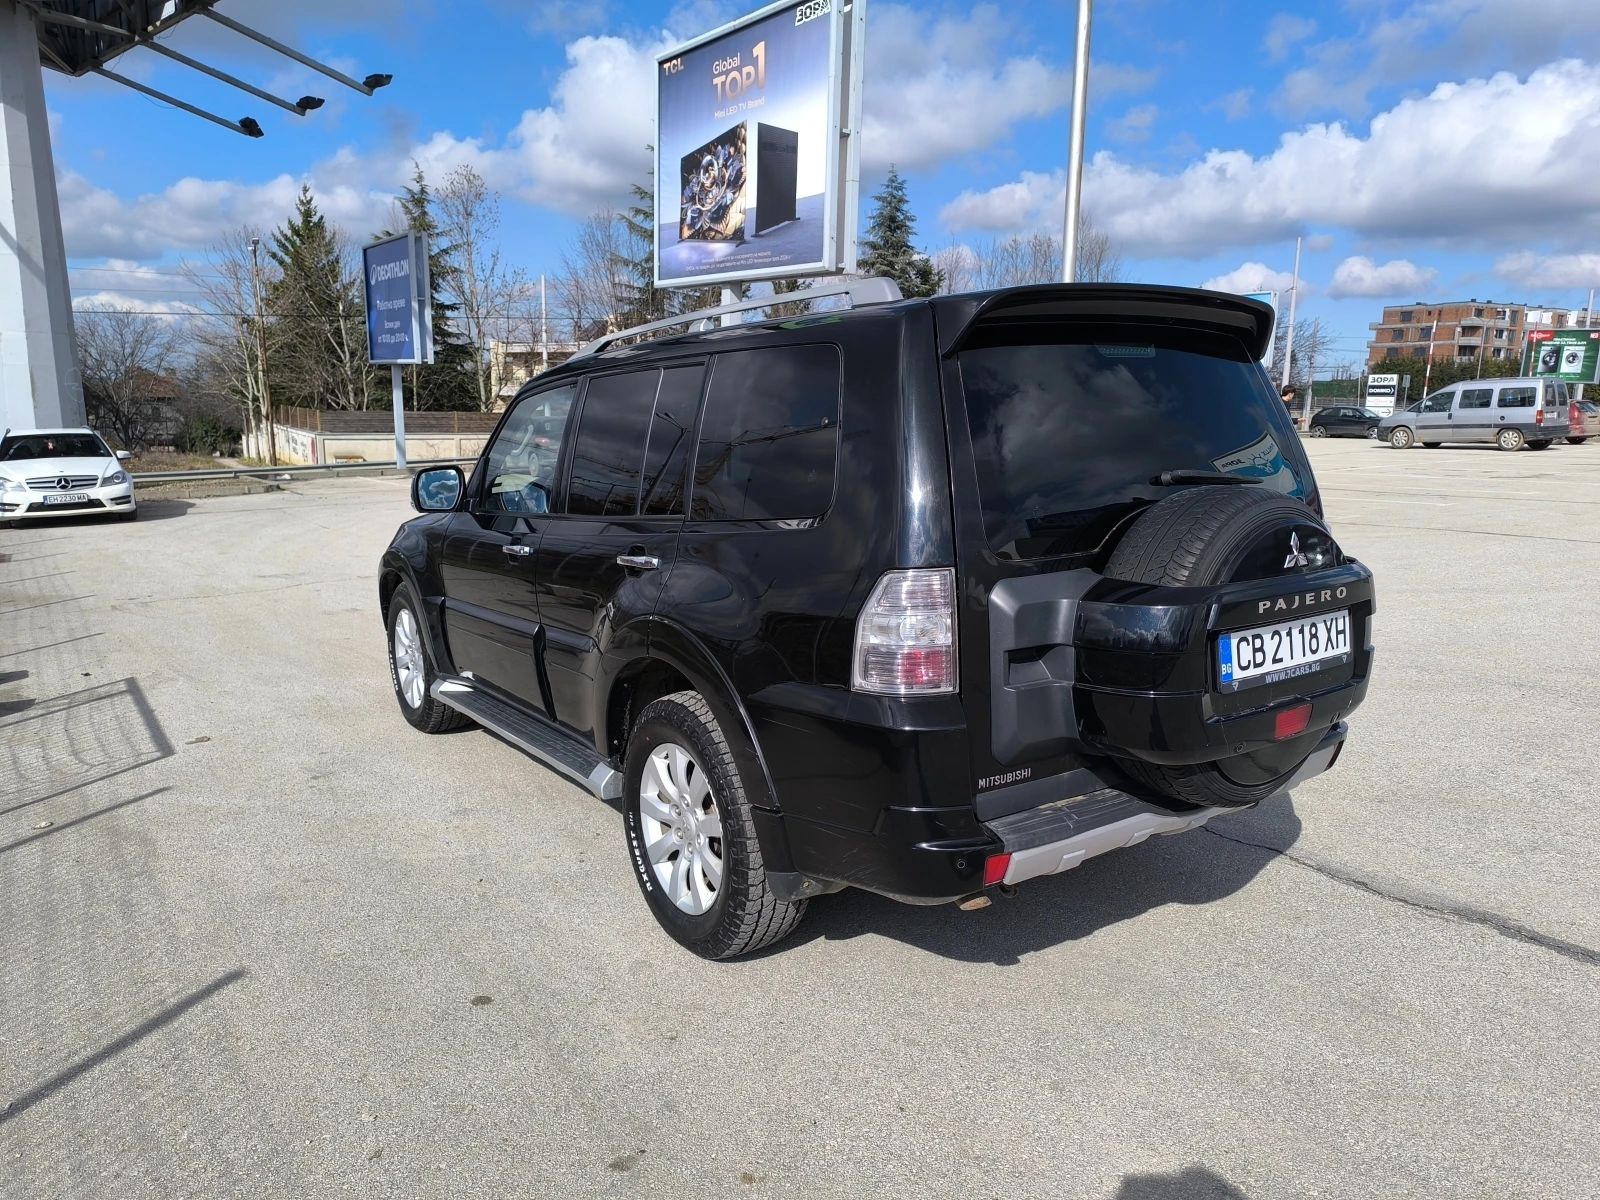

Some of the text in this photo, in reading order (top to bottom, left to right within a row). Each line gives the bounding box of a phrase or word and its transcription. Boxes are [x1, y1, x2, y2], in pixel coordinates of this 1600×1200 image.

[663, 58, 684, 76] TCL
[712, 52, 741, 75] Global
[712, 40, 766, 104] TOP 1
[714, 95, 765, 120] Mini LED TV Brand
[378, 259, 409, 281] DECATHLON
[1258, 586, 1348, 614] PAJERO
[1235, 615, 1348, 672] CB 2118 XH
[1221, 663, 1232, 675] BG
[1265, 662, 1321, 684] WWW.7CARS.BG
[978, 767, 1032, 789] MITSUBISHI
